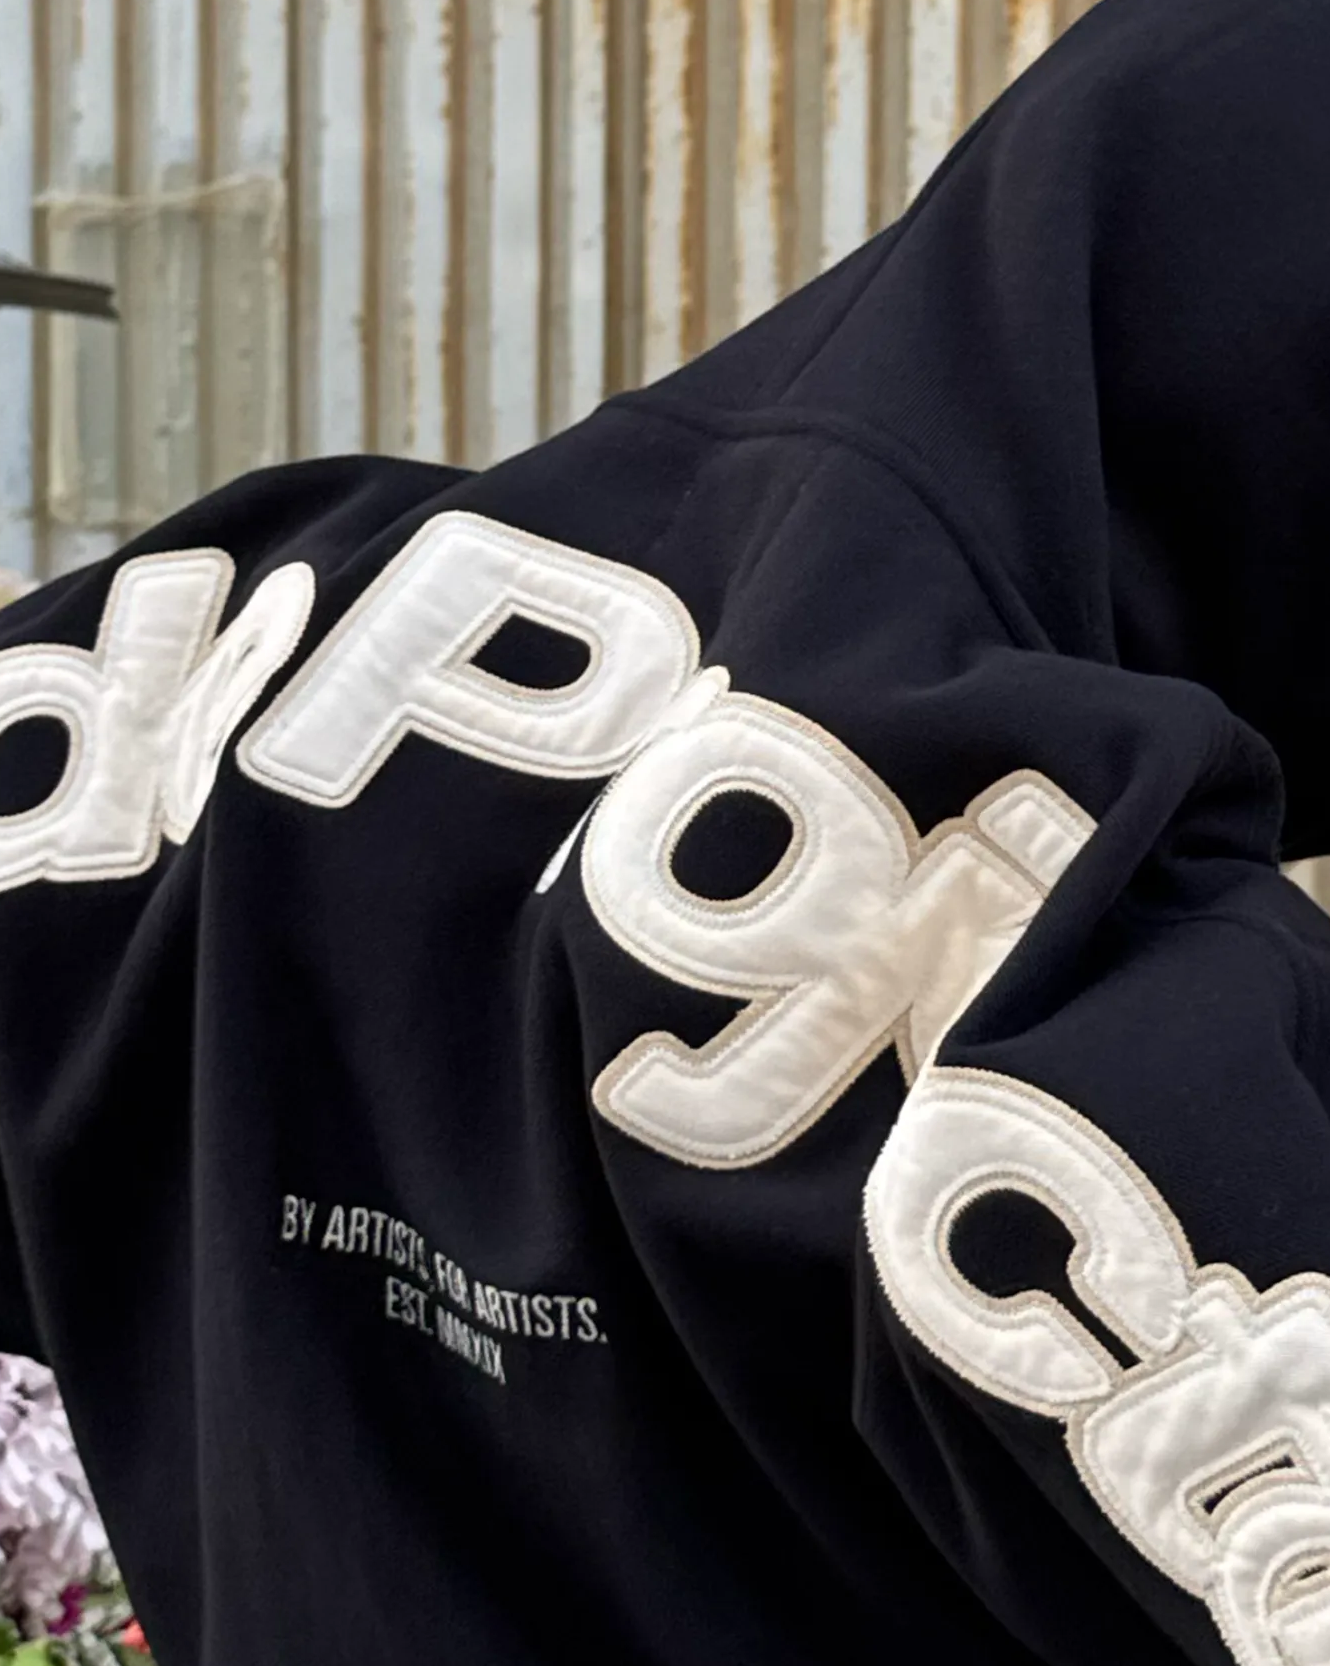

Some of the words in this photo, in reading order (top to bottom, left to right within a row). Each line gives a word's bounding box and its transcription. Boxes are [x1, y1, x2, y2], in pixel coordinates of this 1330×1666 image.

[281, 1194, 316, 1244] BY
[433, 1251, 472, 1311] FOR
[473, 1281, 608, 1343] ARTISTS.
[385, 1276, 434, 1335] EST.
